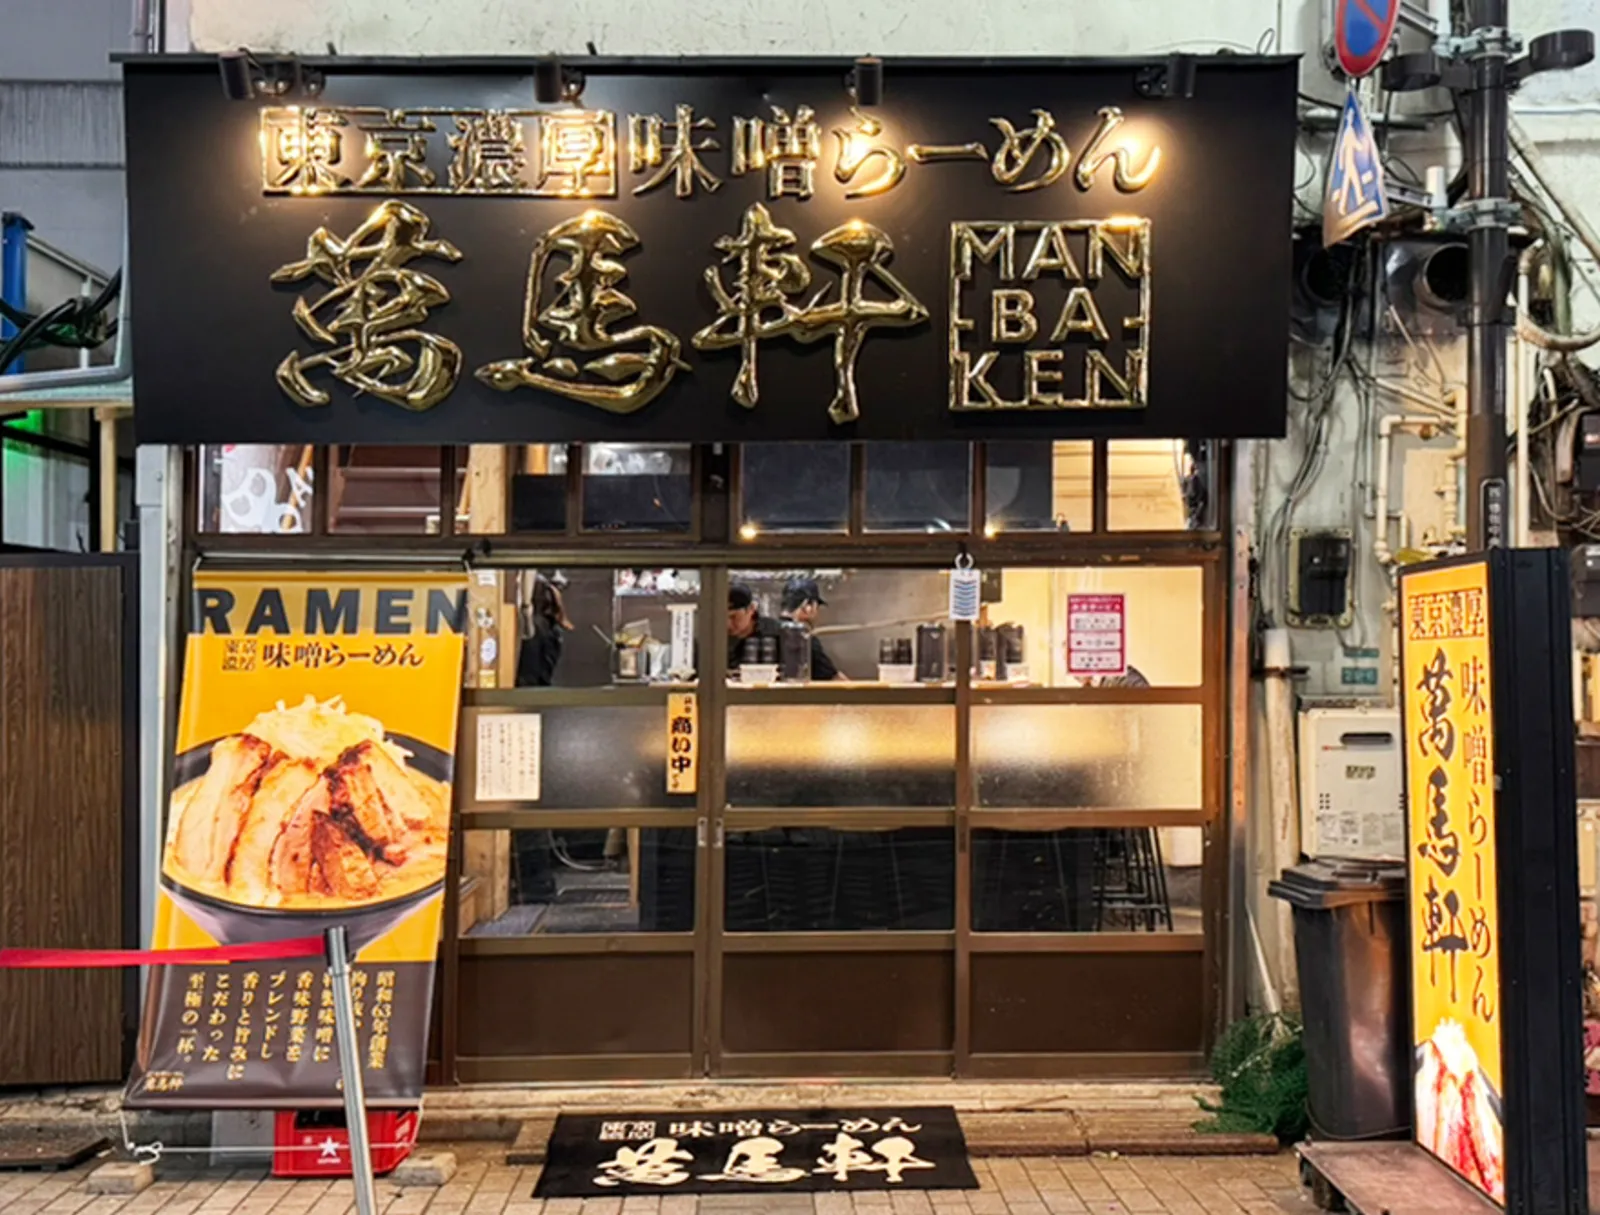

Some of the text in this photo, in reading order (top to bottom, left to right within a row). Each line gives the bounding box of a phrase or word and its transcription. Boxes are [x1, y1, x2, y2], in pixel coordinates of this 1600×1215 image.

[628, 104, 1161, 199] 味噌らーめん
[955, 222, 1143, 280] MAN
[269, 200, 929, 424] 萬馬軒
[952, 350, 1143, 405] KEN
[197, 588, 468, 635] RAMEN
[262, 641, 424, 669] 味噌らーめん
[202, 973, 230, 1062] こだわった
